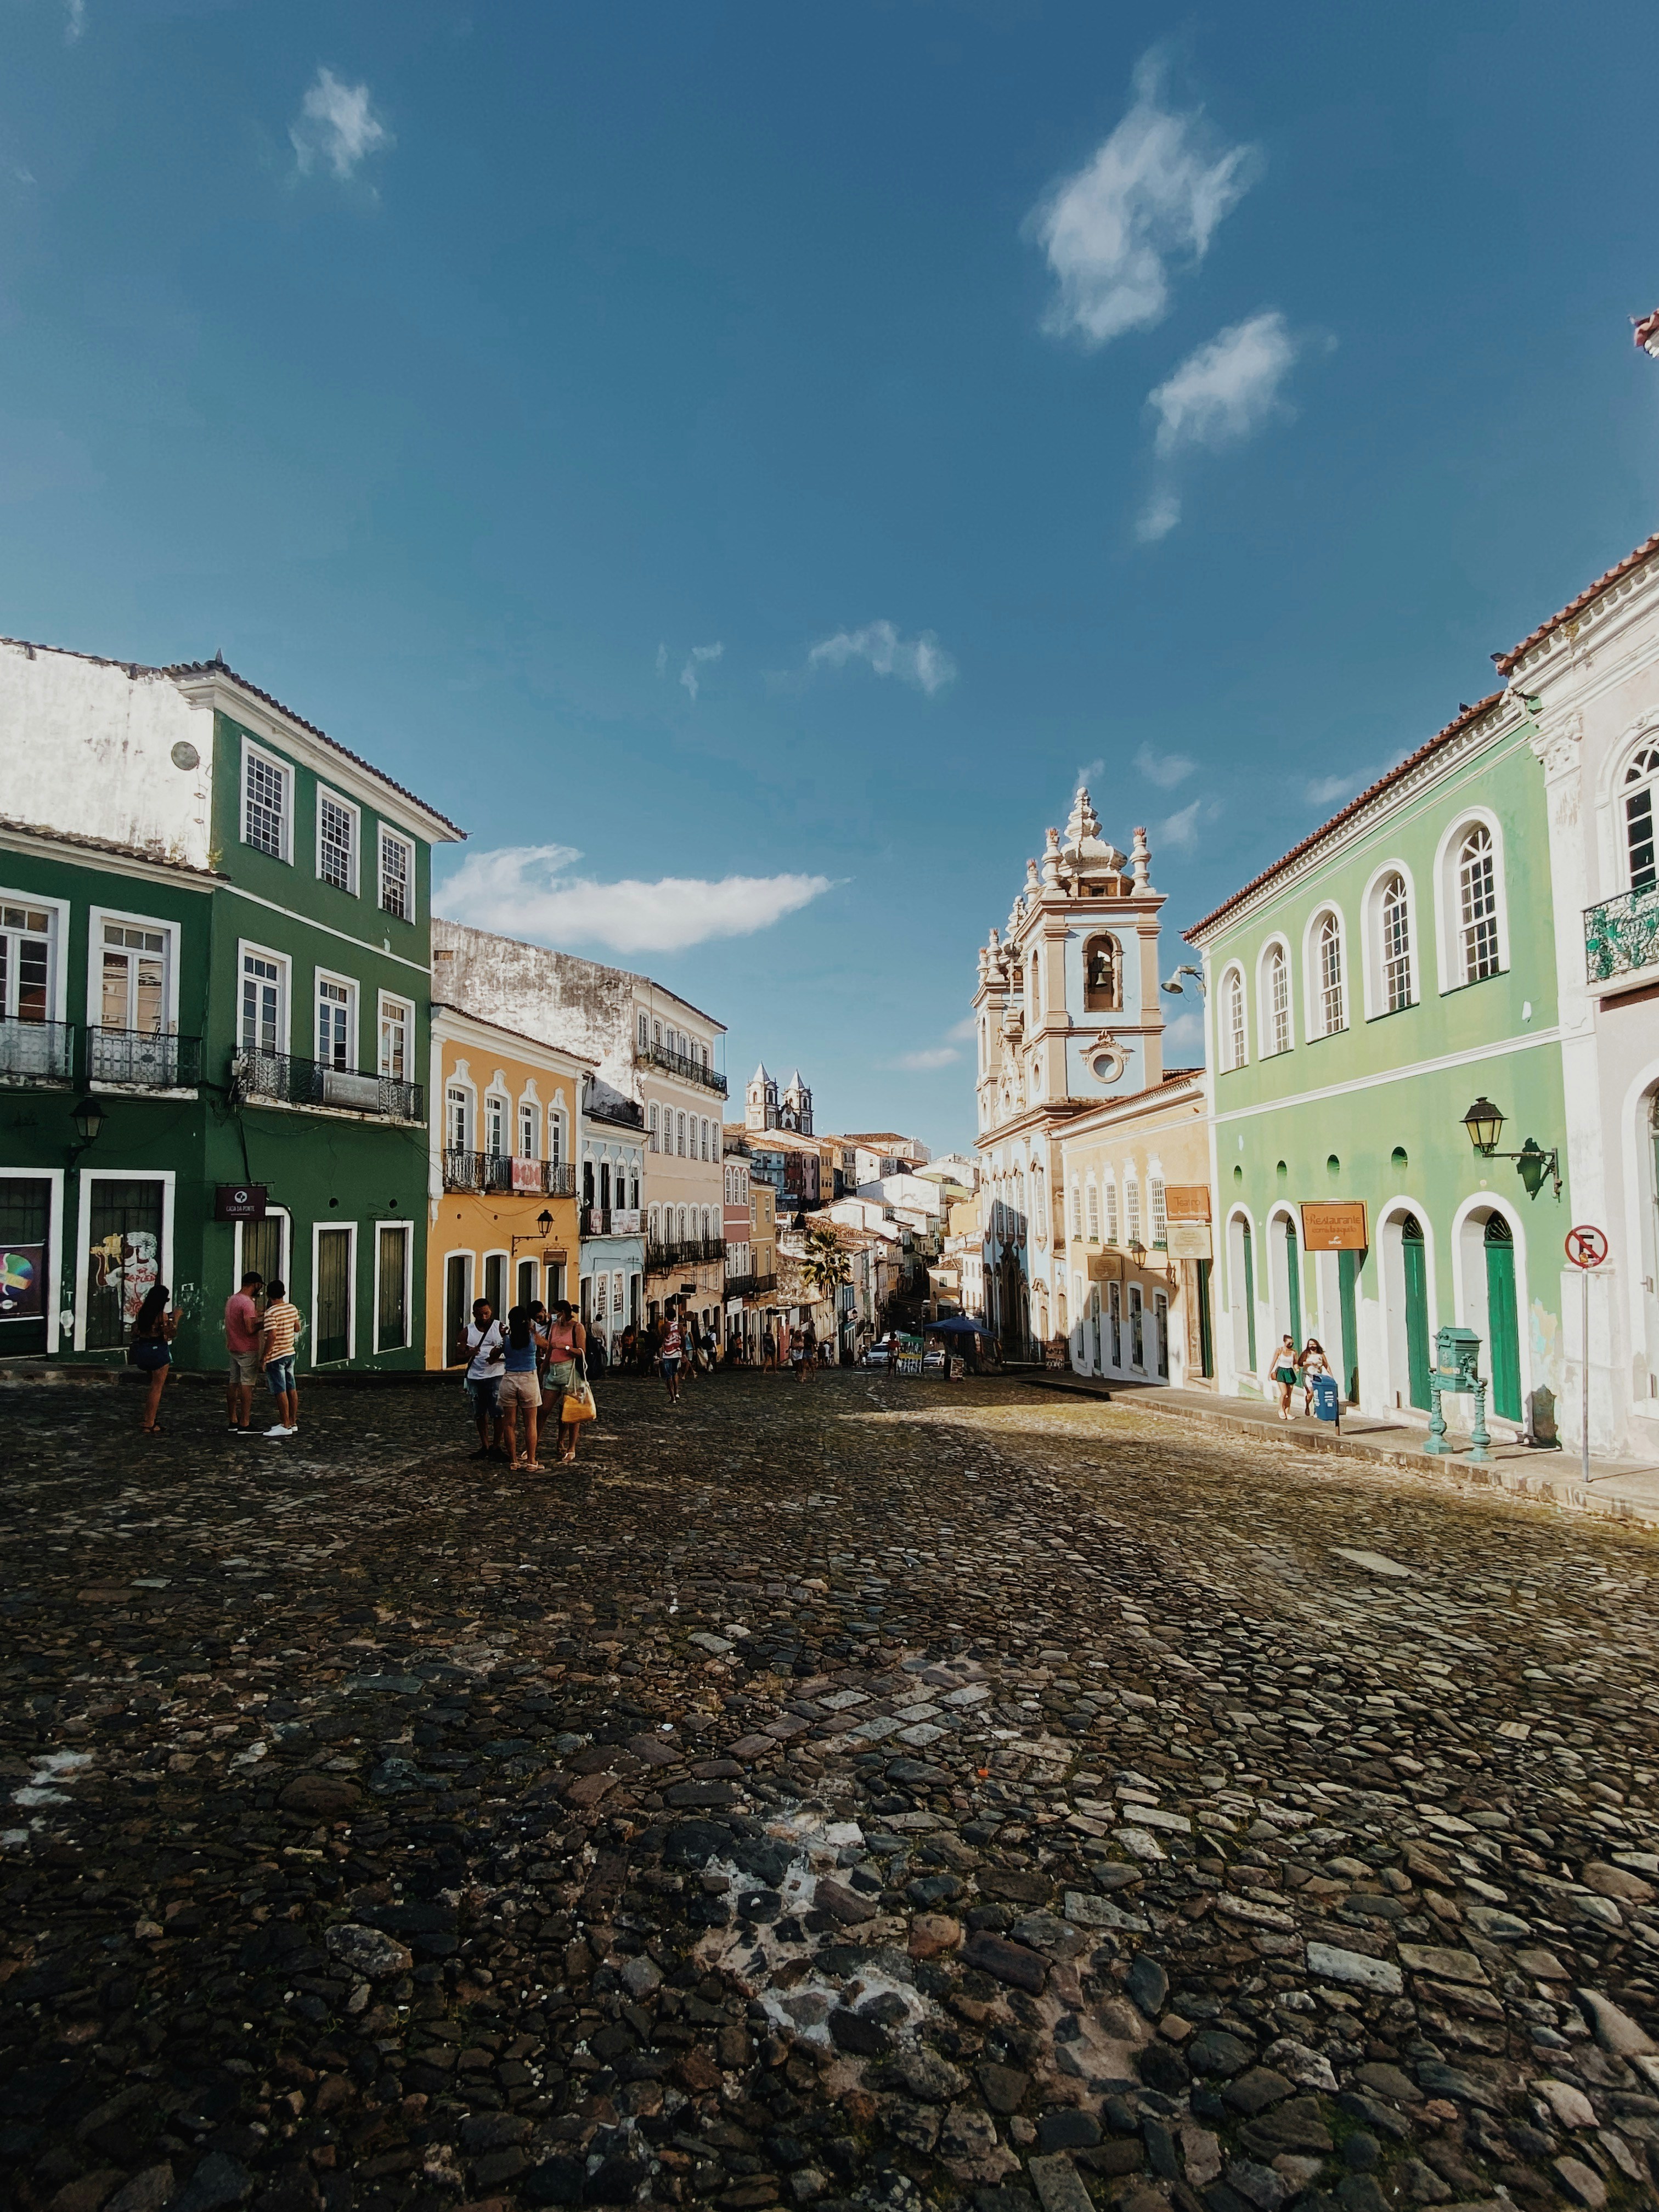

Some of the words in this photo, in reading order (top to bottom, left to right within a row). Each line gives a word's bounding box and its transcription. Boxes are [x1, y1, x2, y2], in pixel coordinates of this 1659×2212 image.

[1173, 1197, 1200, 1206] Teatro
[1306, 1213, 1362, 1225] Restaurante
[1579, 1234, 1594, 1259] E
